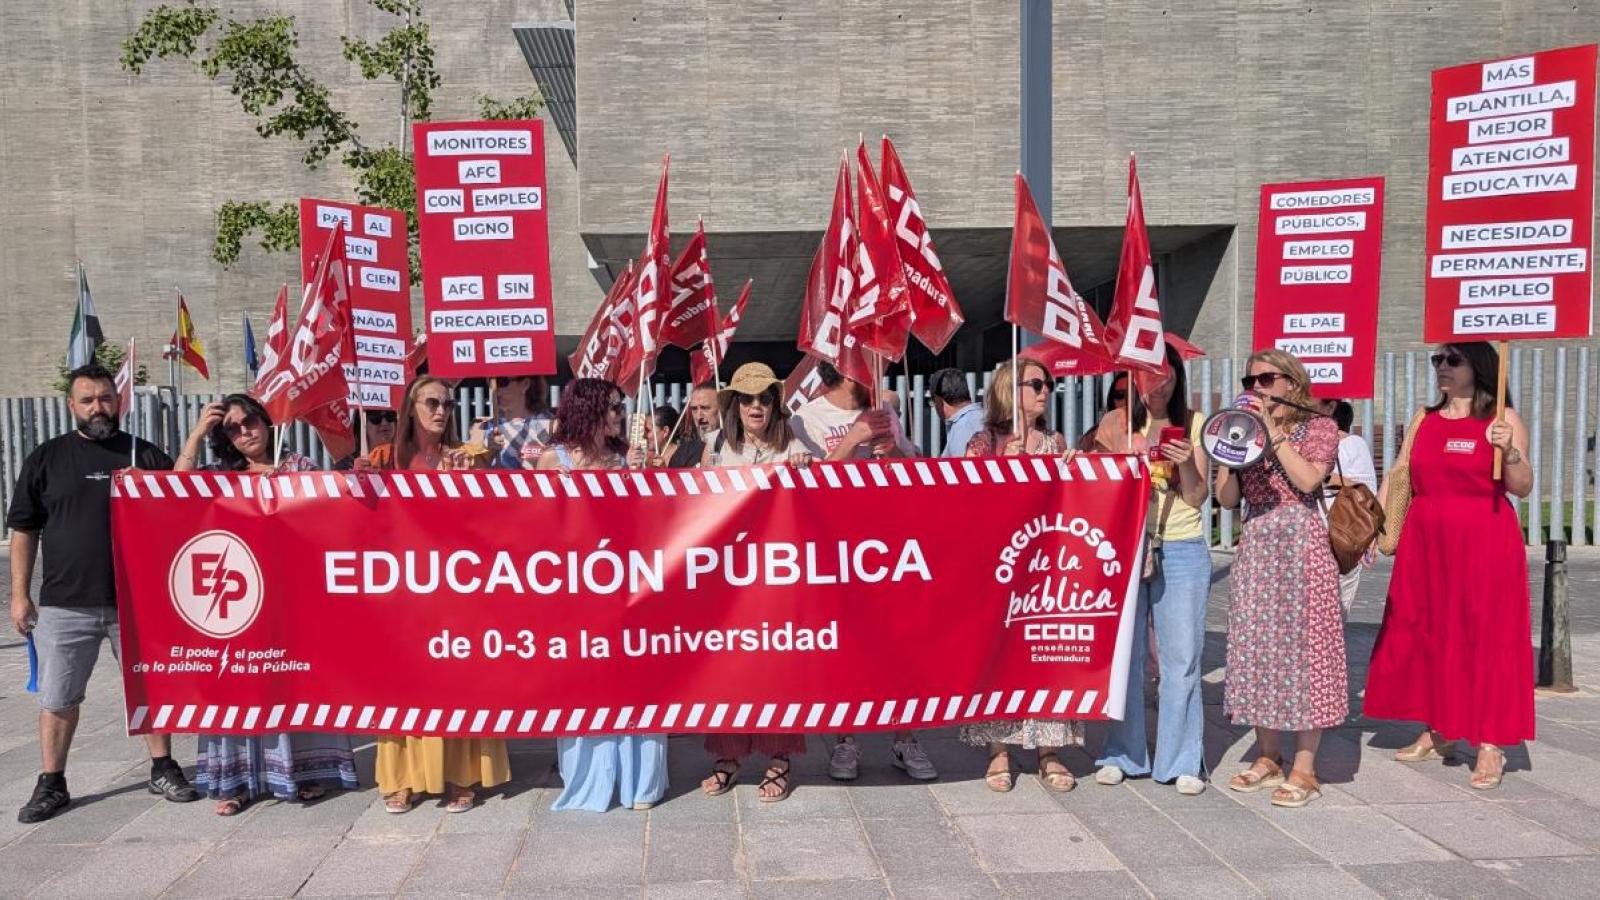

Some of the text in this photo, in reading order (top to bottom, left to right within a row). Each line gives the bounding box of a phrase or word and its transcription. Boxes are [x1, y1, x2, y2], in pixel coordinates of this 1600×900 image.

[1487, 64, 1530, 83] MÁS
[1455, 89, 1571, 115] PLANTILLA,
[1477, 118, 1547, 137] MEJOR
[433, 137, 528, 150] MONITORES
[1460, 143, 1562, 167] ATENCIÓN
[465, 166, 496, 178] AFC
[1451, 172, 1568, 195] EDUCATIVA
[428, 192, 539, 207] CON EMPLEO
[1276, 192, 1371, 207] COMEDORES
[323, 213, 386, 232] PAE AL
[457, 222, 510, 235] DIGNO
[1281, 216, 1360, 229] PÚBLICOS,
[1450, 224, 1567, 242] NECESIDAD
[1289, 244, 1350, 256] EMPLEO
[1440, 253, 1584, 272] PERMANENTE,
[366, 273, 396, 285] CIEN
[1284, 268, 1348, 281] PÚBLICO
[448, 282, 529, 295] AFC SIN
[1468, 282, 1549, 298] EMPLEO
[352, 315, 394, 328] NADA
[433, 314, 545, 327] PRECARIEDAD
[1289, 317, 1340, 328] EL PAE
[1461, 312, 1547, 328] ESTABLE
[456, 345, 528, 357] NI CESE
[1280, 341, 1347, 354] TAMBIÉN
[344, 367, 400, 381] NTRATO
[1307, 368, 1339, 379] UCA
[324, 532, 932, 595] EDUCACIÓN PÚBLICA
[1028, 545, 1082, 573] de la
[1004, 576, 1117, 628] pública
[1024, 623, 1094, 641] CCOO
[429, 620, 839, 659] de 0-3 a la Universidad
[170, 646, 219, 659] El poder
[235, 648, 286, 661] el poder
[1030, 644, 1090, 652] enseñanza
[1031, 654, 1091, 663] Extremadura
[133, 660, 213, 674] de lo público
[231, 660, 311, 674] de la Pública
